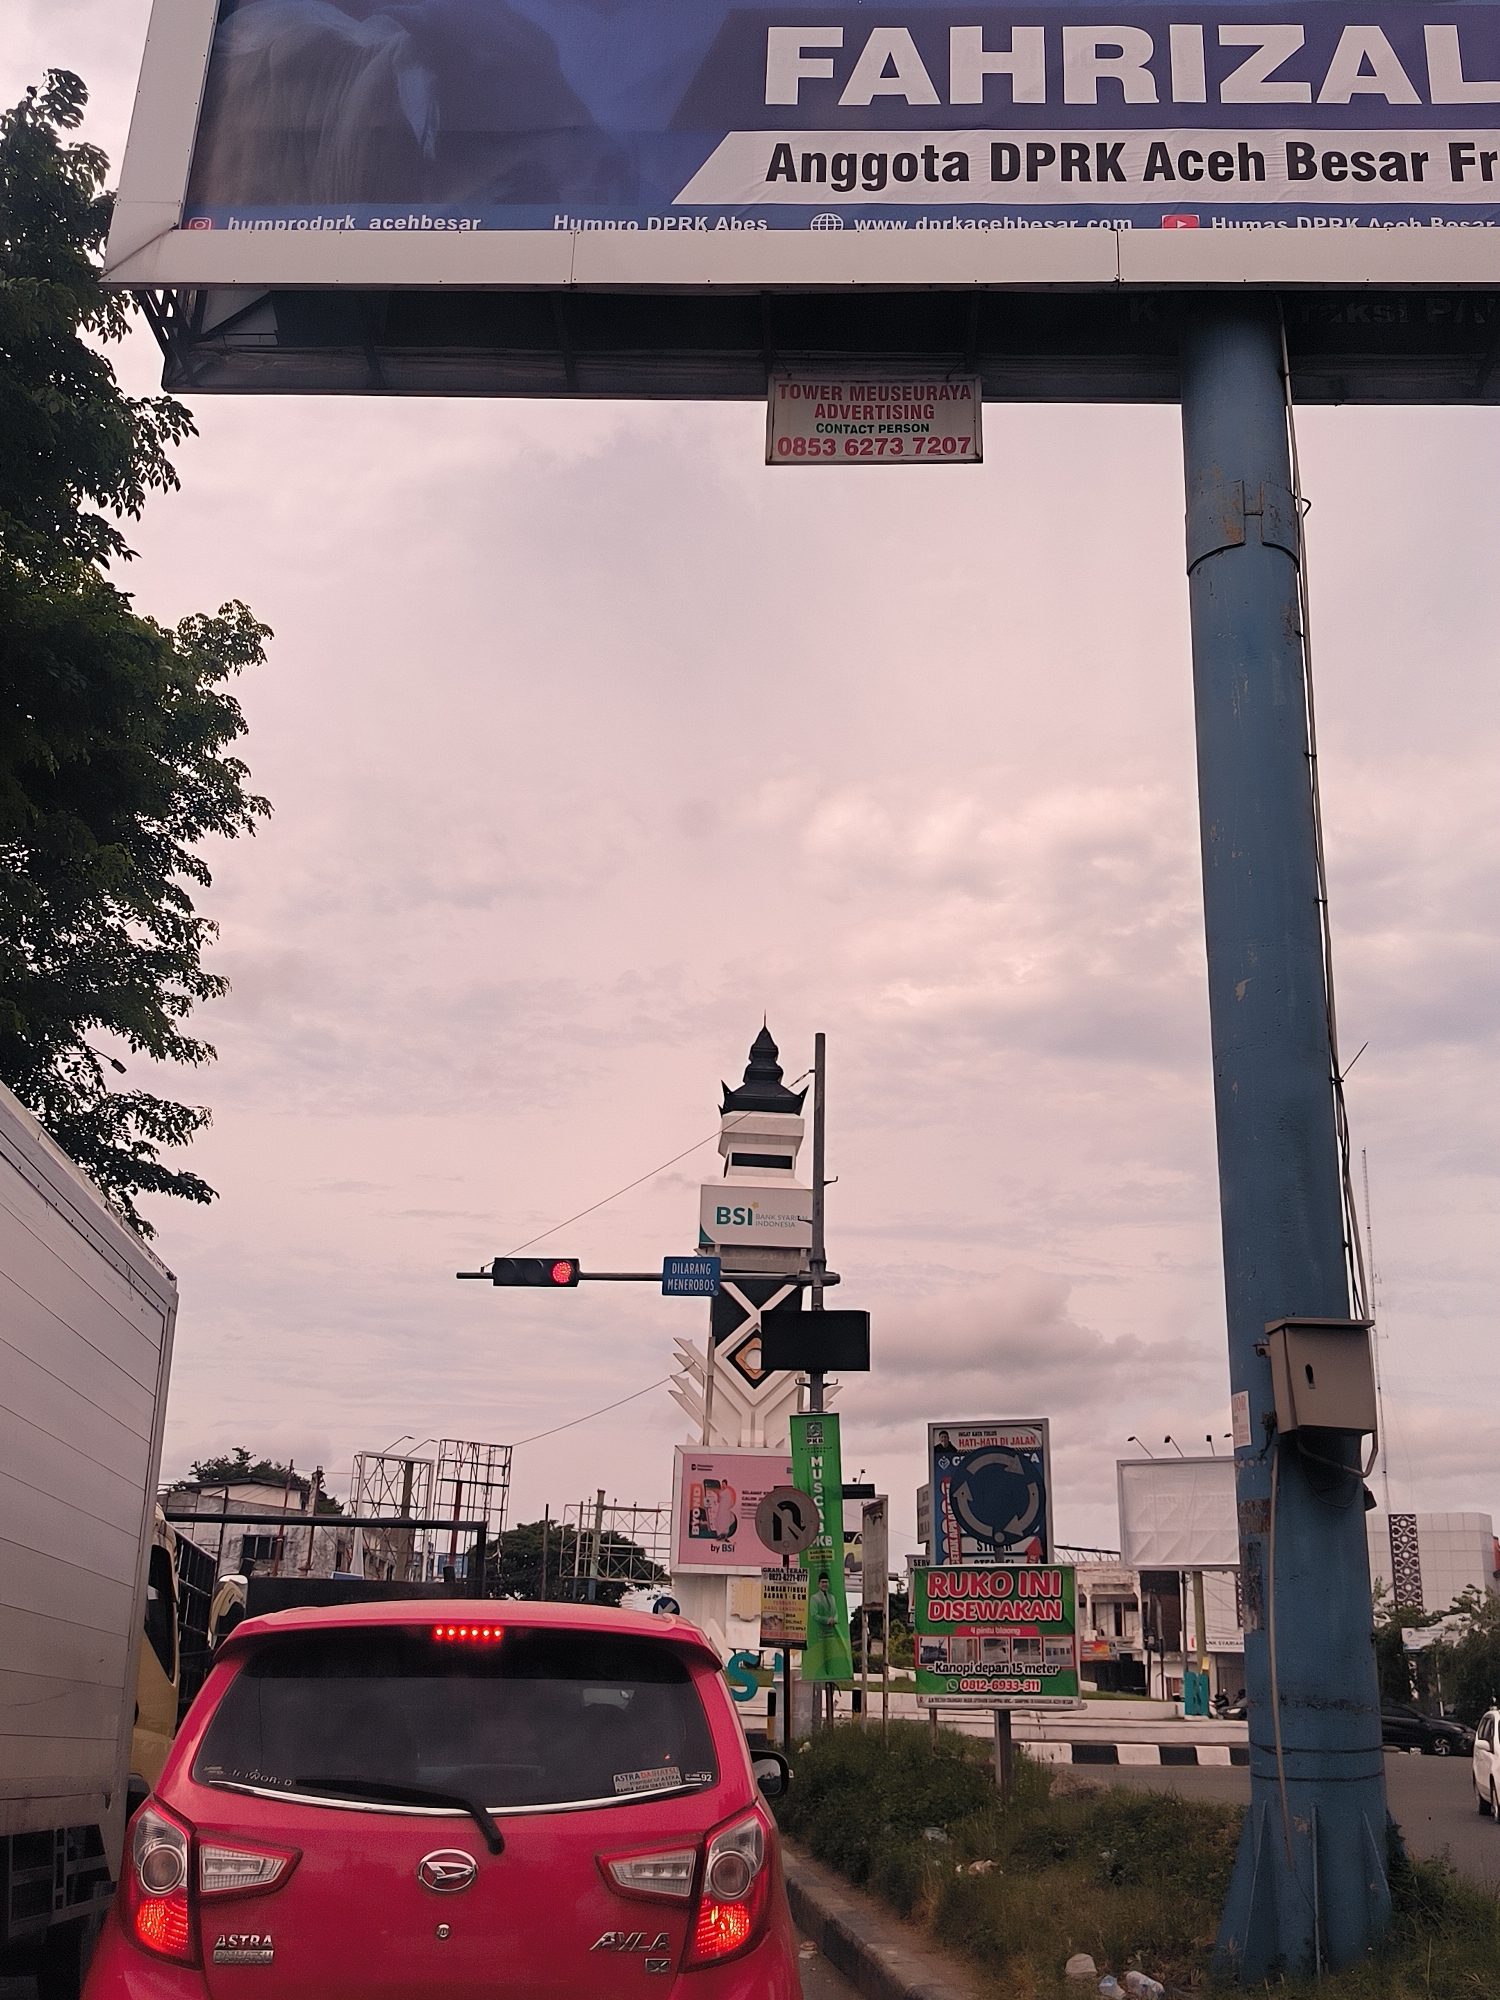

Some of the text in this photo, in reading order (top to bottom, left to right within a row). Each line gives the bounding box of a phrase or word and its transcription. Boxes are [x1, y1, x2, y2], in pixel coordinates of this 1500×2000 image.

[765, 24, 1500, 105] FAHRIZAL
[765, 143, 969, 192] Anggota
[990, 142, 1127, 182] DPRK
[1143, 142, 1266, 181] Aceh
[1286, 142, 1428, 182] Besar
[553, 214, 768, 231] Humpro DPRK Abes
[1211, 216, 1287, 230] Humas
[1297, 216, 1359, 230] DPRK
[778, 383, 972, 402] TOWER MEUSEURAYA
[814, 403, 935, 420] ADVERTISING
[816, 422, 930, 434] CONTACT PERSON
[777, 436, 972, 457] 0853 6273 7207
[716, 1206, 753, 1226] BSI
[755, 1220, 796, 1228] INDONESIA
[671, 1262, 711, 1275] DILARANG
[667, 1279, 715, 1292] MENEROBOS
[958, 1436, 1036, 1447] HATI-HATI DI JALAN
[710, 1543, 735, 1554] by BSI
[786, 1567, 808, 1575] TERAPI
[927, 1571, 1063, 1599] RUKO INI
[928, 1600, 1063, 1622] DISEWAKAN
[935, 1662, 974, 1676] Kanopi
[977, 1663, 1010, 1676] depan
[1012, 1663, 1023, 1674] 15
[1024, 1664, 1059, 1675] meter
[960, 1679, 1041, 1692] 0812-6933-311
[214, 1934, 274, 1949] ASTRA
[589, 1931, 670, 1952] AYLA
